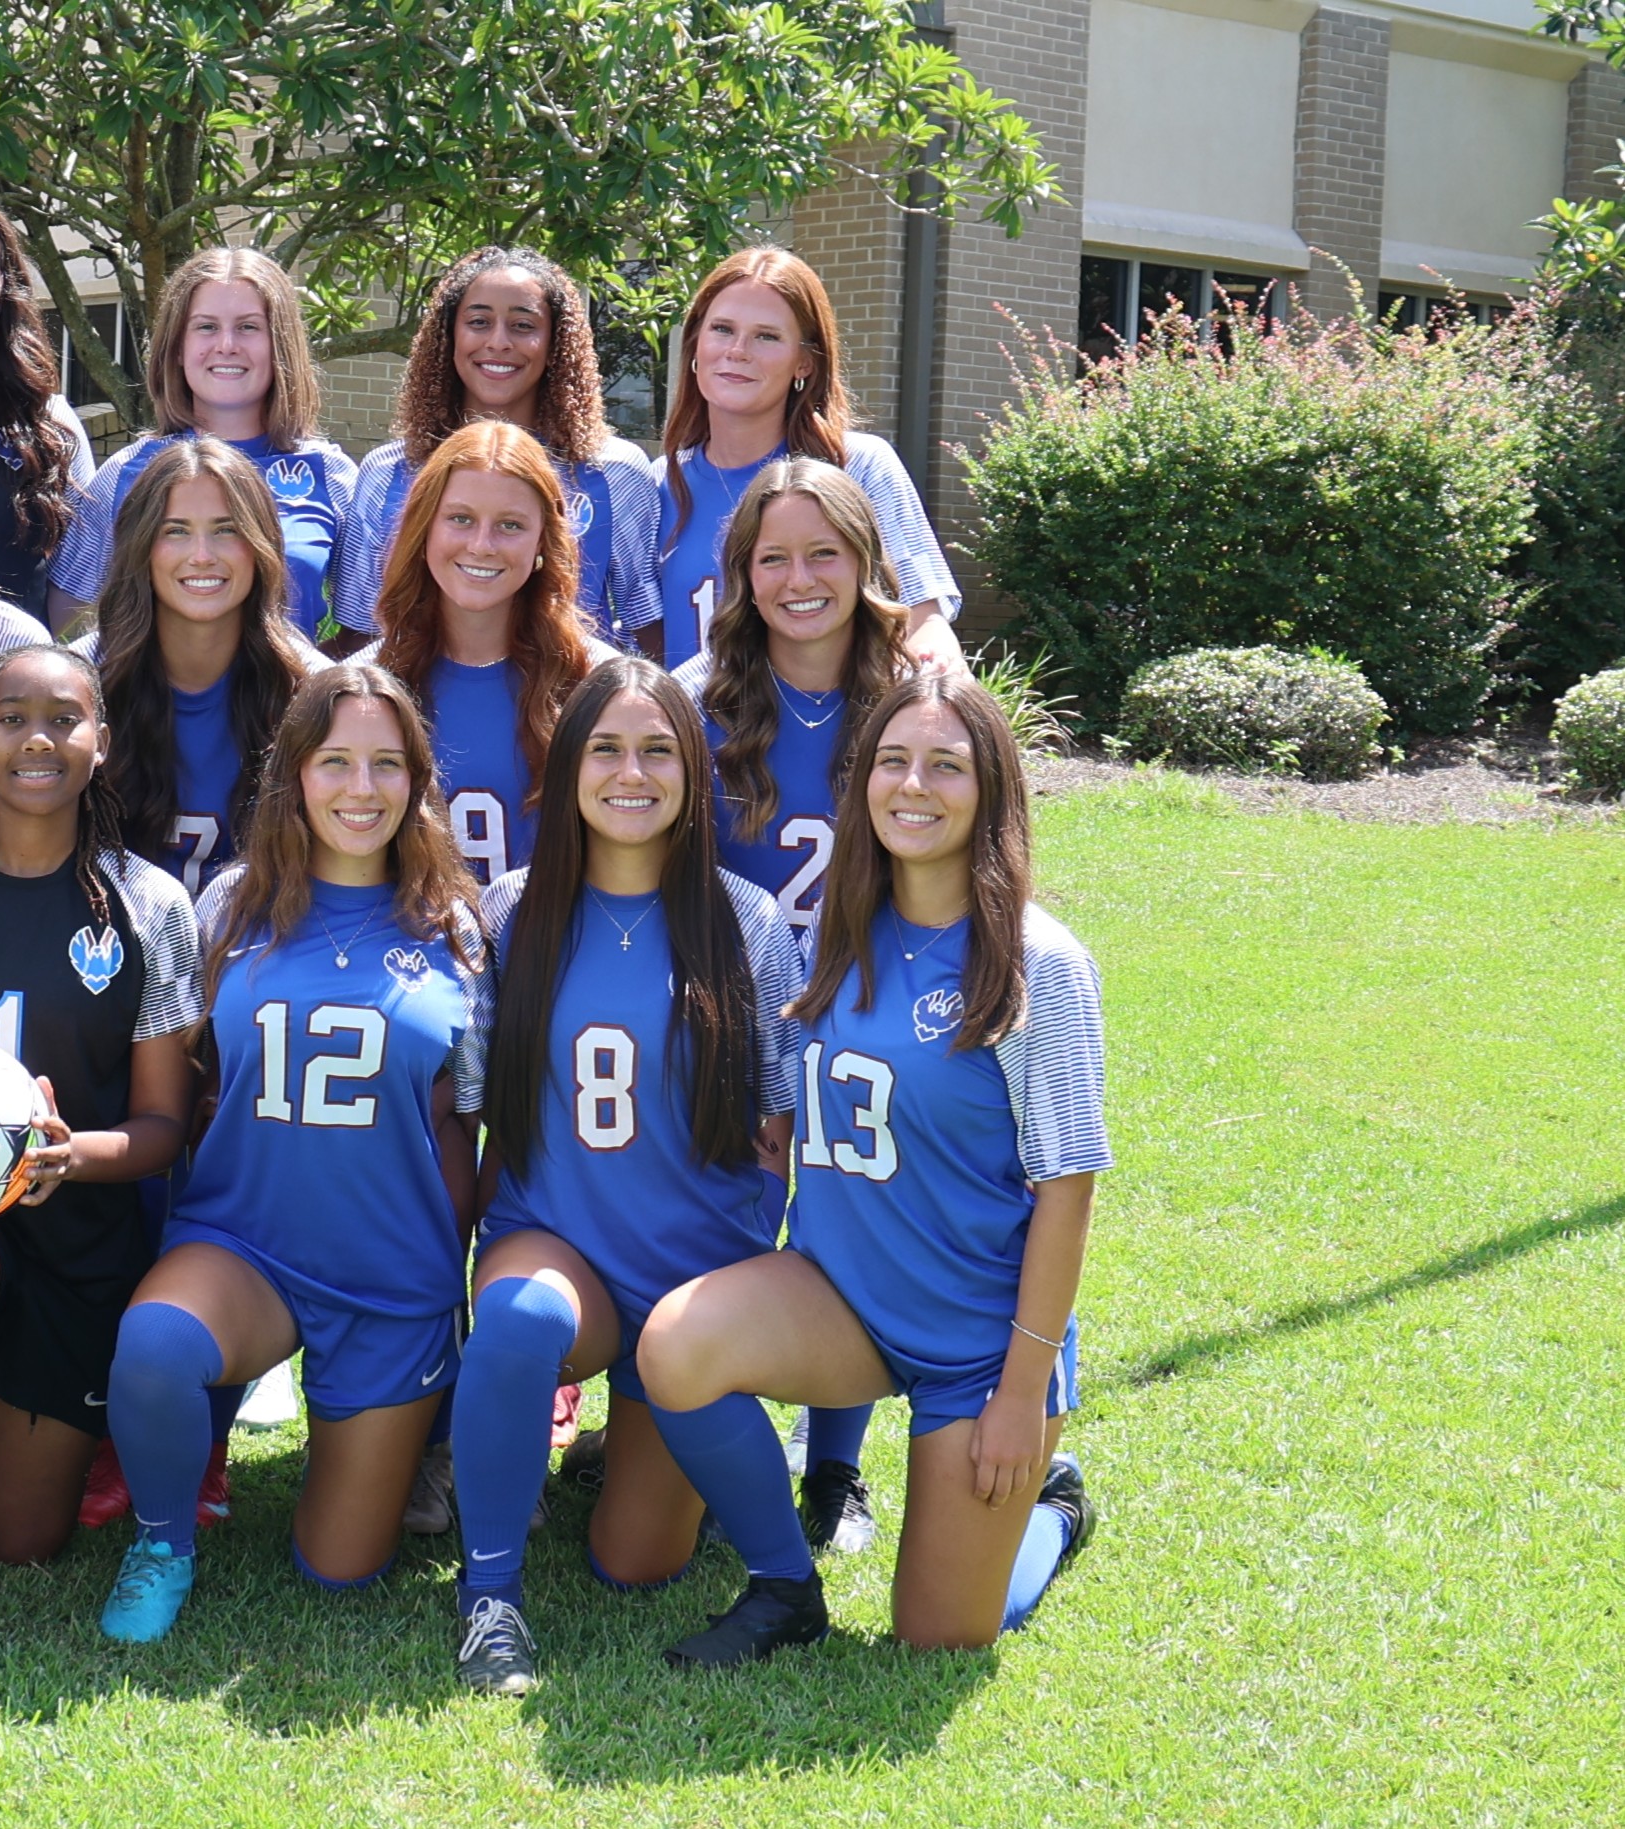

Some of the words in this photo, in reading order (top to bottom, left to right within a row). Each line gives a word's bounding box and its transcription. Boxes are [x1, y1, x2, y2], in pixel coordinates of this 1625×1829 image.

[163, 811, 220, 895] 7
[448, 786, 510, 894] 9
[776, 813, 835, 928] 2
[254, 1001, 388, 1128] 12
[574, 1023, 639, 1152] 8
[800, 1039, 897, 1182] 13
